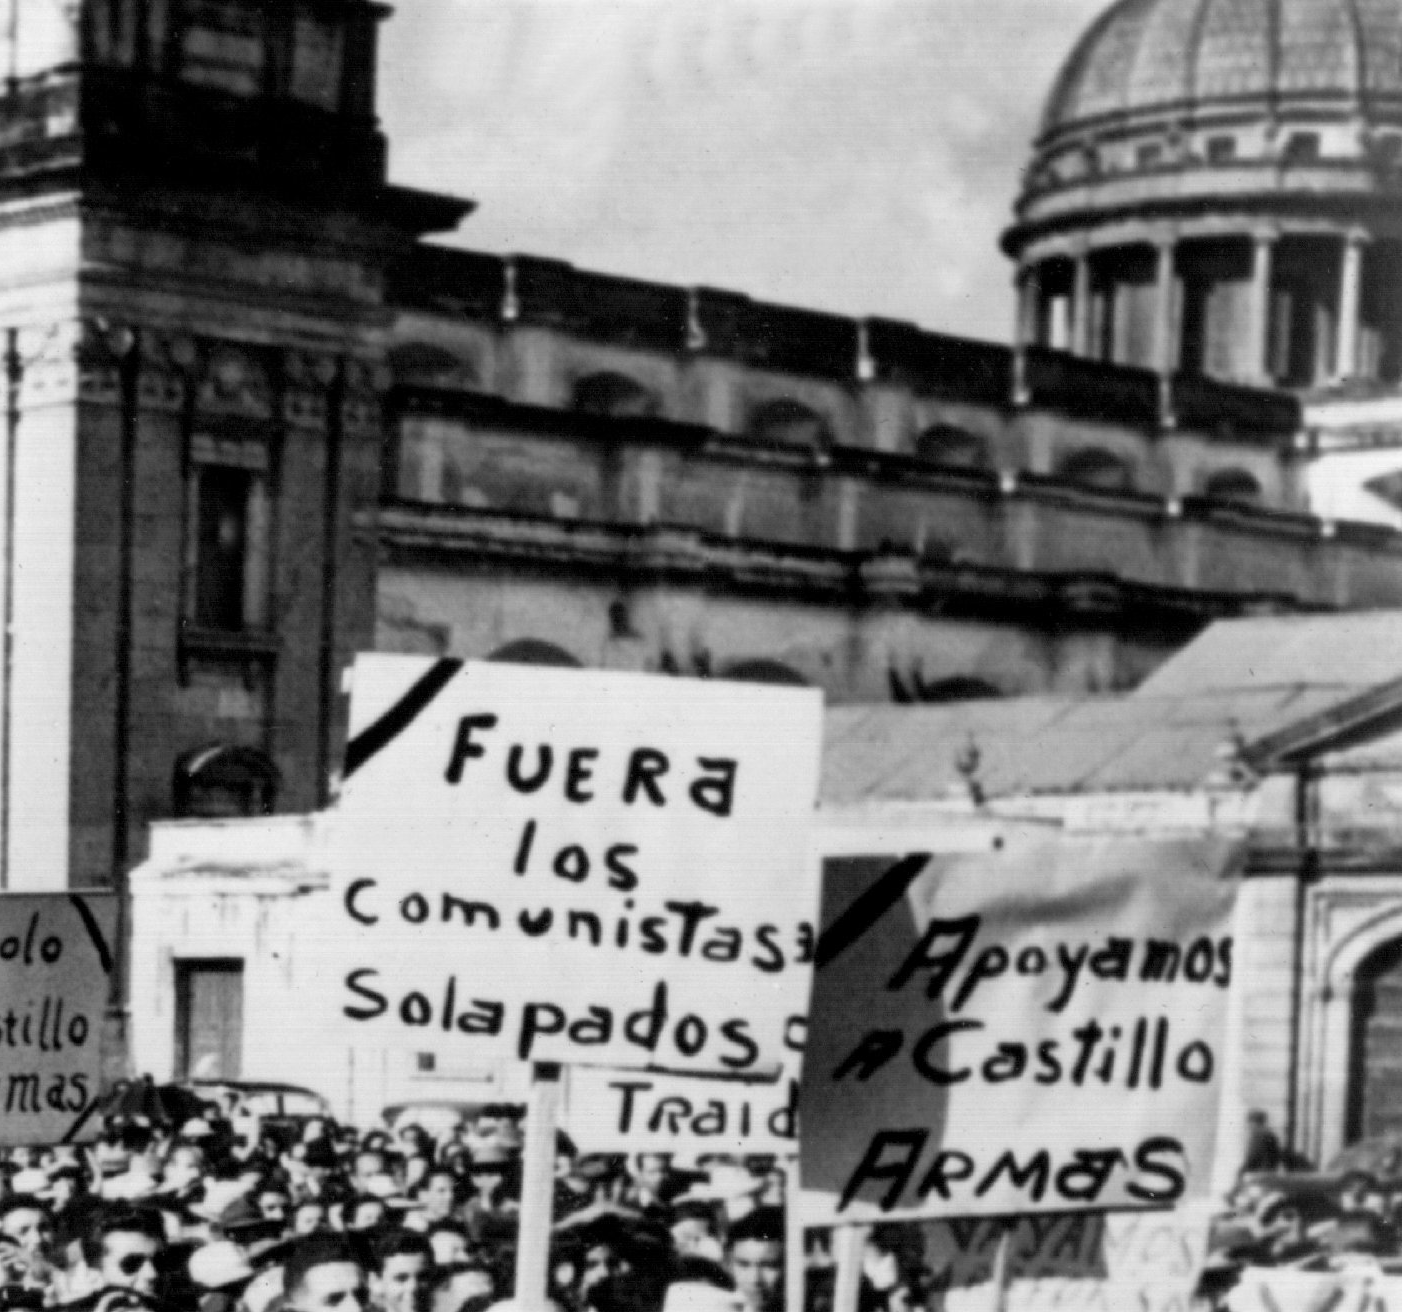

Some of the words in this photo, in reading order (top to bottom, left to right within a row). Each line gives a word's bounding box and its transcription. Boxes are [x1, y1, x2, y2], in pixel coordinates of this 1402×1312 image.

[512, 818, 640, 893] los
[886, 914, 1235, 1013] Apoyamos
[342, 967, 761, 1069] Solapados
[911, 1015, 1215, 1091] Castillo
